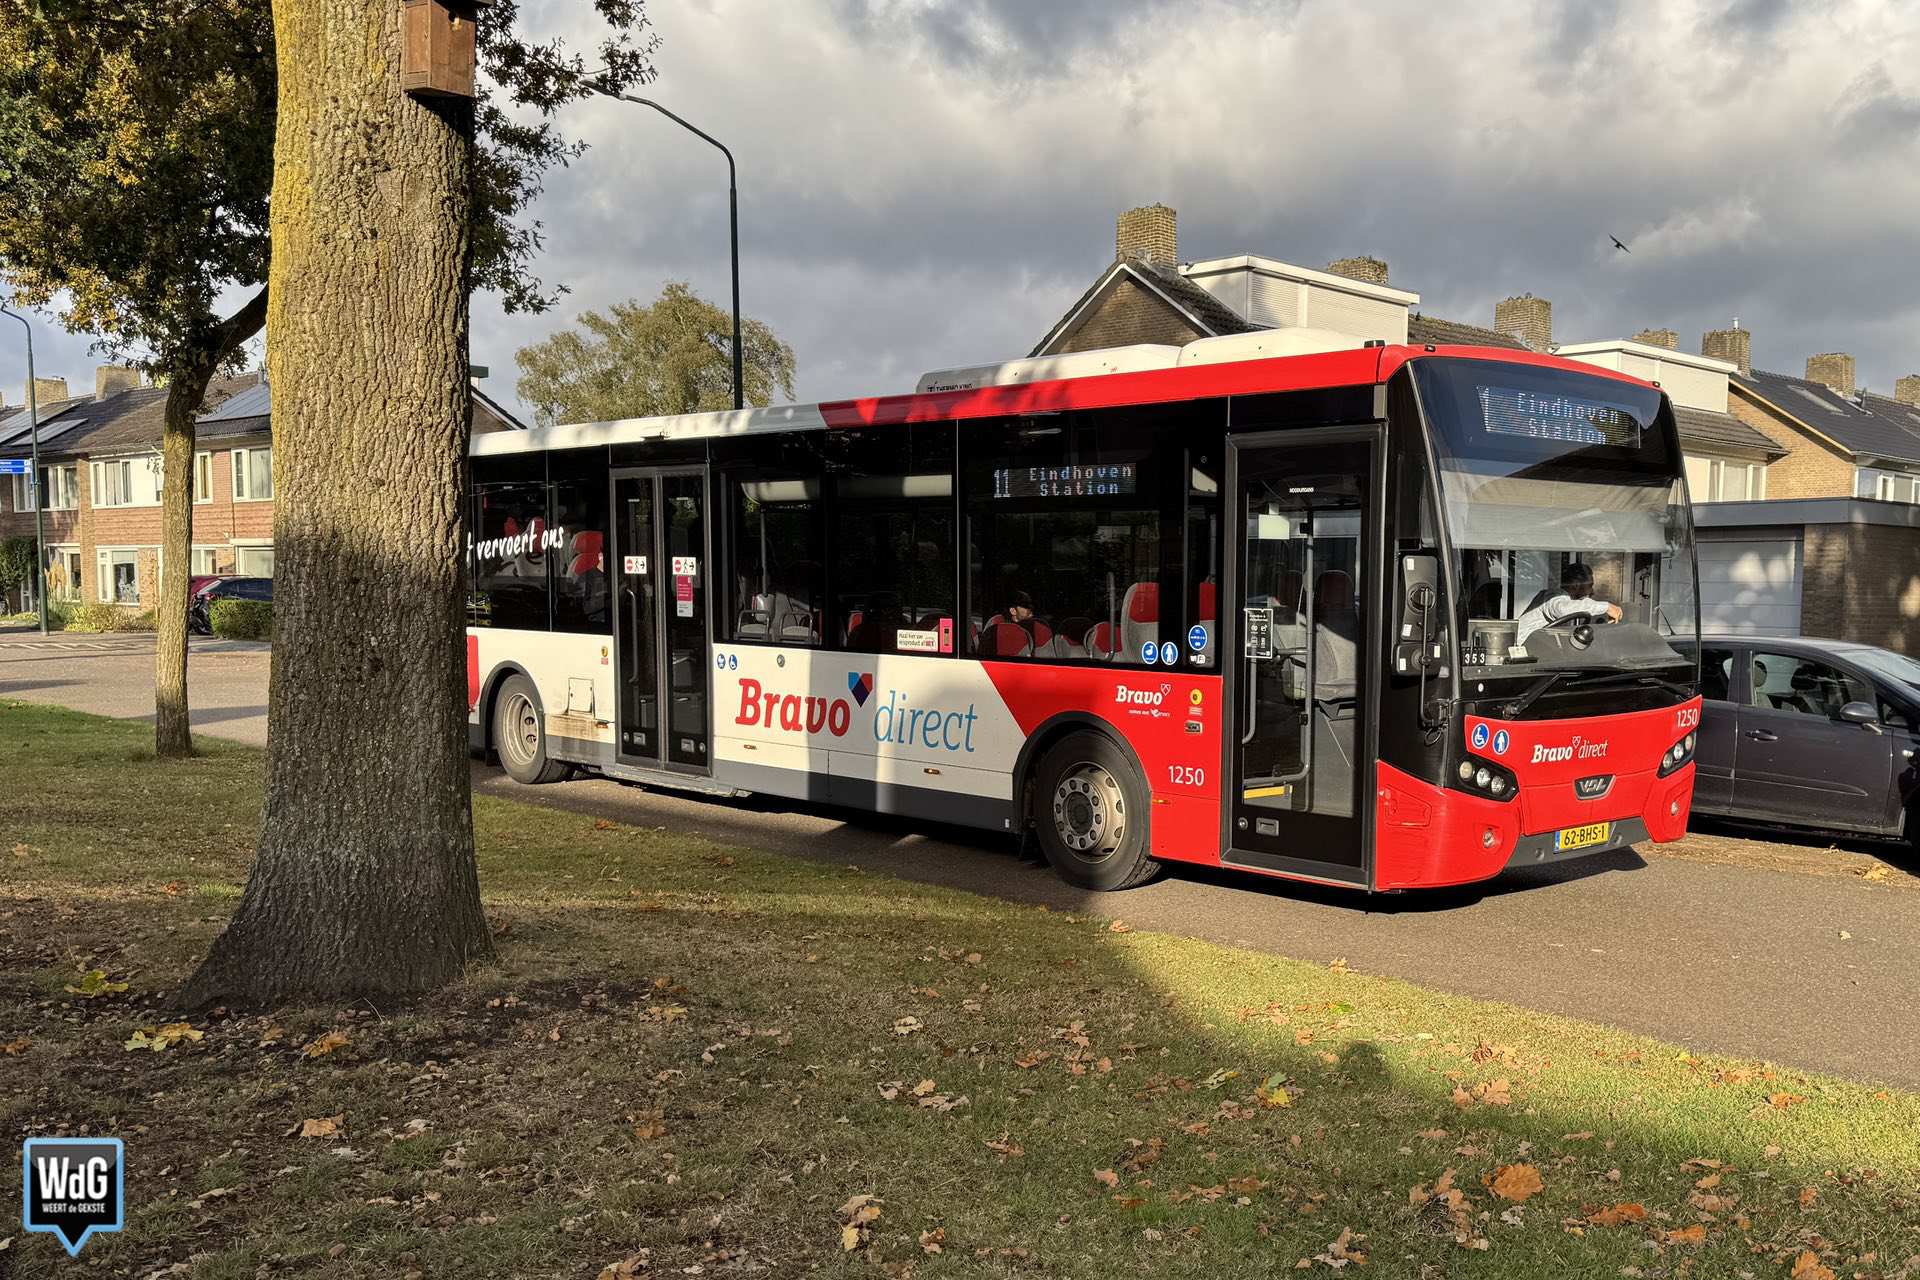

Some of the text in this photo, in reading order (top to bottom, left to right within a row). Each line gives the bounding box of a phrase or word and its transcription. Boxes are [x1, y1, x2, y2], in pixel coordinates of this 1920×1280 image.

[1517, 392, 1619, 424] Eindhoven
[1528, 418, 1606, 445] Station
[993, 465, 1132, 499] 11 Eindhoven
[1039, 482, 1119, 497] Station
[476, 519, 538, 561] vervoert
[541, 526, 564, 551] ons
[1115, 685, 1163, 706] Bravo
[735, 678, 978, 752] Bravo direct
[1677, 708, 1698, 728] 1250
[1531, 739, 1608, 764] Bravo direct
[1168, 766, 1205, 787] 1250
[1579, 778, 1608, 793] VDL
[1564, 825, 1605, 846] 62-BHS-1
